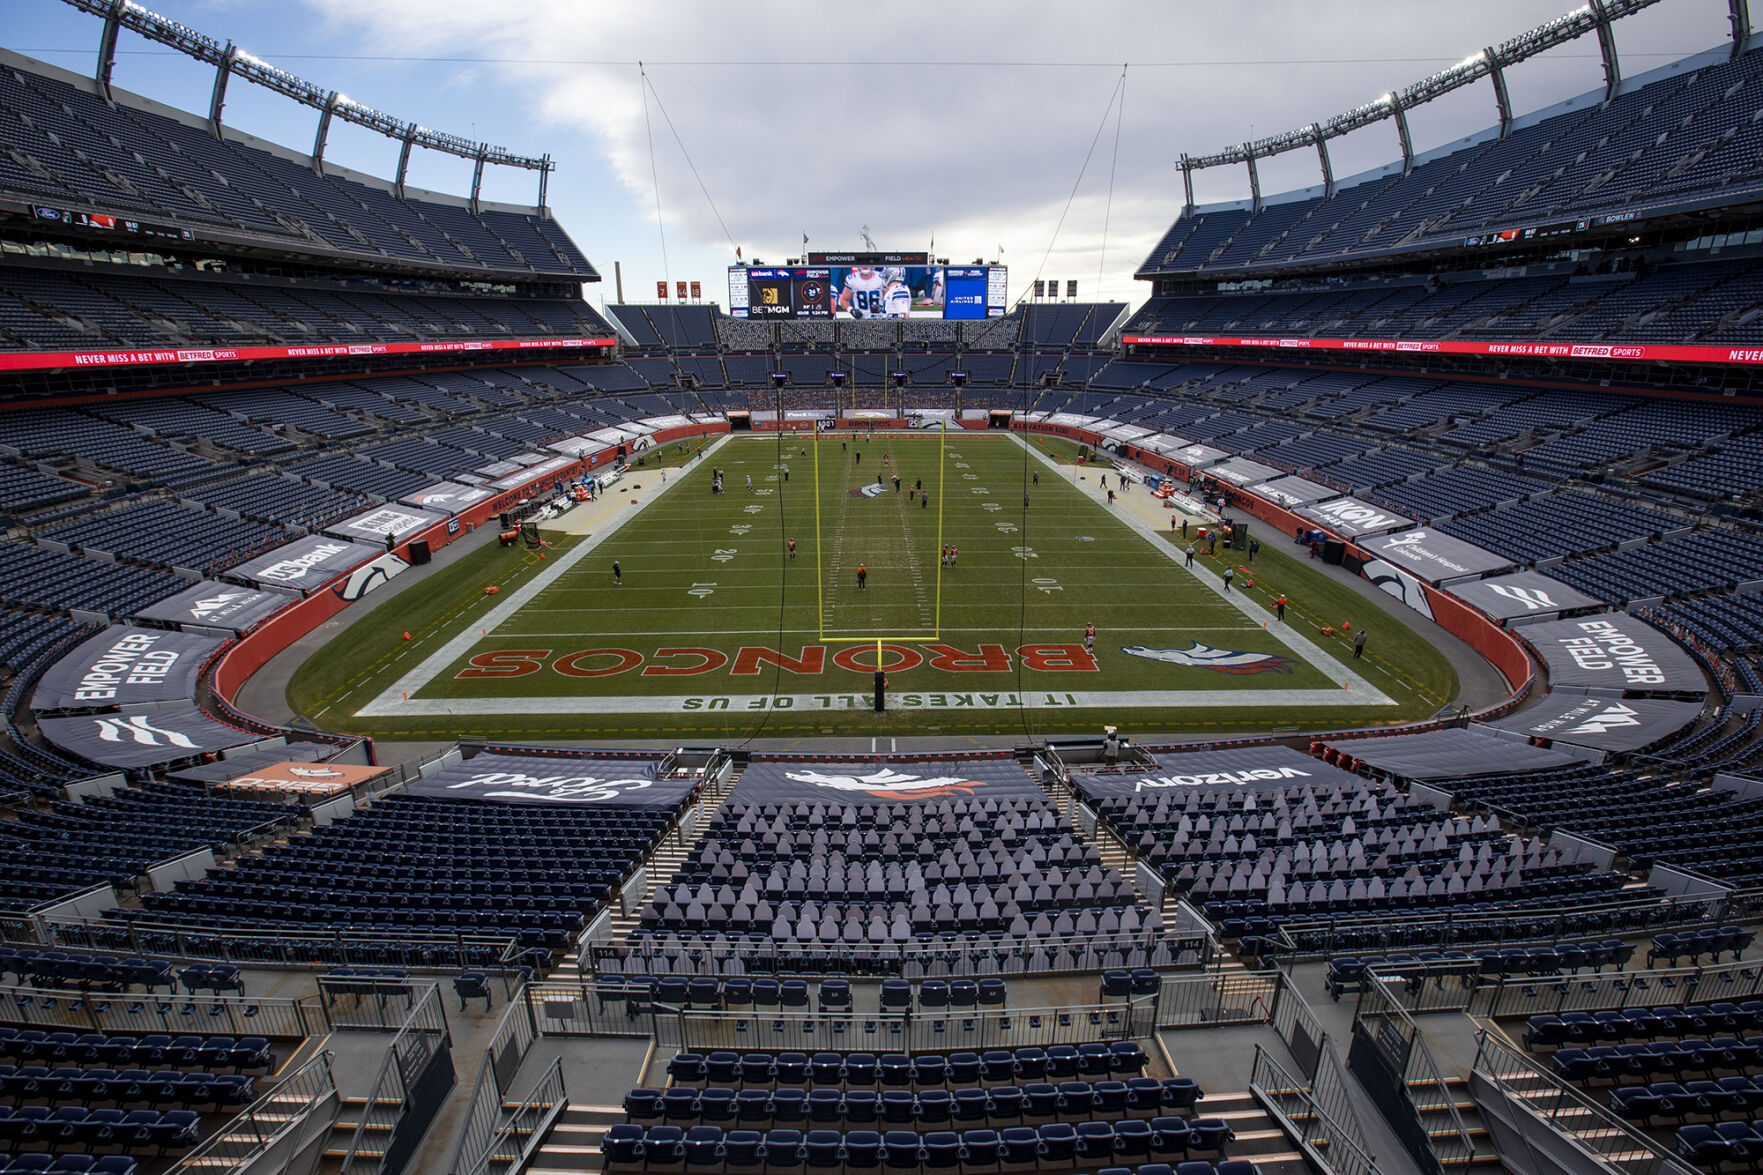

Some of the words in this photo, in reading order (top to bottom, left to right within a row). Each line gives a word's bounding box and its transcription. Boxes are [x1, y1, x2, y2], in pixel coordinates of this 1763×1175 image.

[1606, 212, 1634, 224] BOWLEN
[752, 306, 790, 314] BETMGM
[75, 353, 106, 364] NEVER
[107, 352, 128, 363] MISS
[130, 352, 137, 362] A
[138, 351, 153, 361] BET
[154, 351, 175, 361] WITH
[180, 351, 212, 360] BETFRED
[214, 350, 236, 358] SPORTS
[1510, 345, 1526, 353] MISS
[1534, 346, 1547, 354] BET
[1549, 346, 1568, 355] WITH
[1572, 347, 1608, 356] BETFRED
[1612, 348, 1641, 356] SPORTS
[1014, 423, 1054, 432] ELEVATION
[492, 492, 520, 512] WELCOME
[1320, 500, 1396, 529] IKON
[729, 524, 752, 534] 30
[994, 522, 1018, 532] 30
[710, 548, 737, 561] 20
[1011, 546, 1039, 558] 20
[1437, 557, 1469, 572] Hospital
[688, 582, 718, 595] 10
[1032, 578, 1064, 591] 10
[1558, 638, 1613, 670] FIELD
[1576, 620, 1666, 684] EMPOWER
[74, 634, 160, 700] EMPOWER
[126, 650, 180, 684] FIELD
[454, 643, 1100, 679] BRONCOS
[682, 697, 730, 710] US
[748, 696, 794, 709] OF
[901, 694, 1024, 707] TAKES
[1045, 693, 1076, 706] IT
[1135, 766, 1312, 793] verizon
[446, 772, 654, 802] Ford
